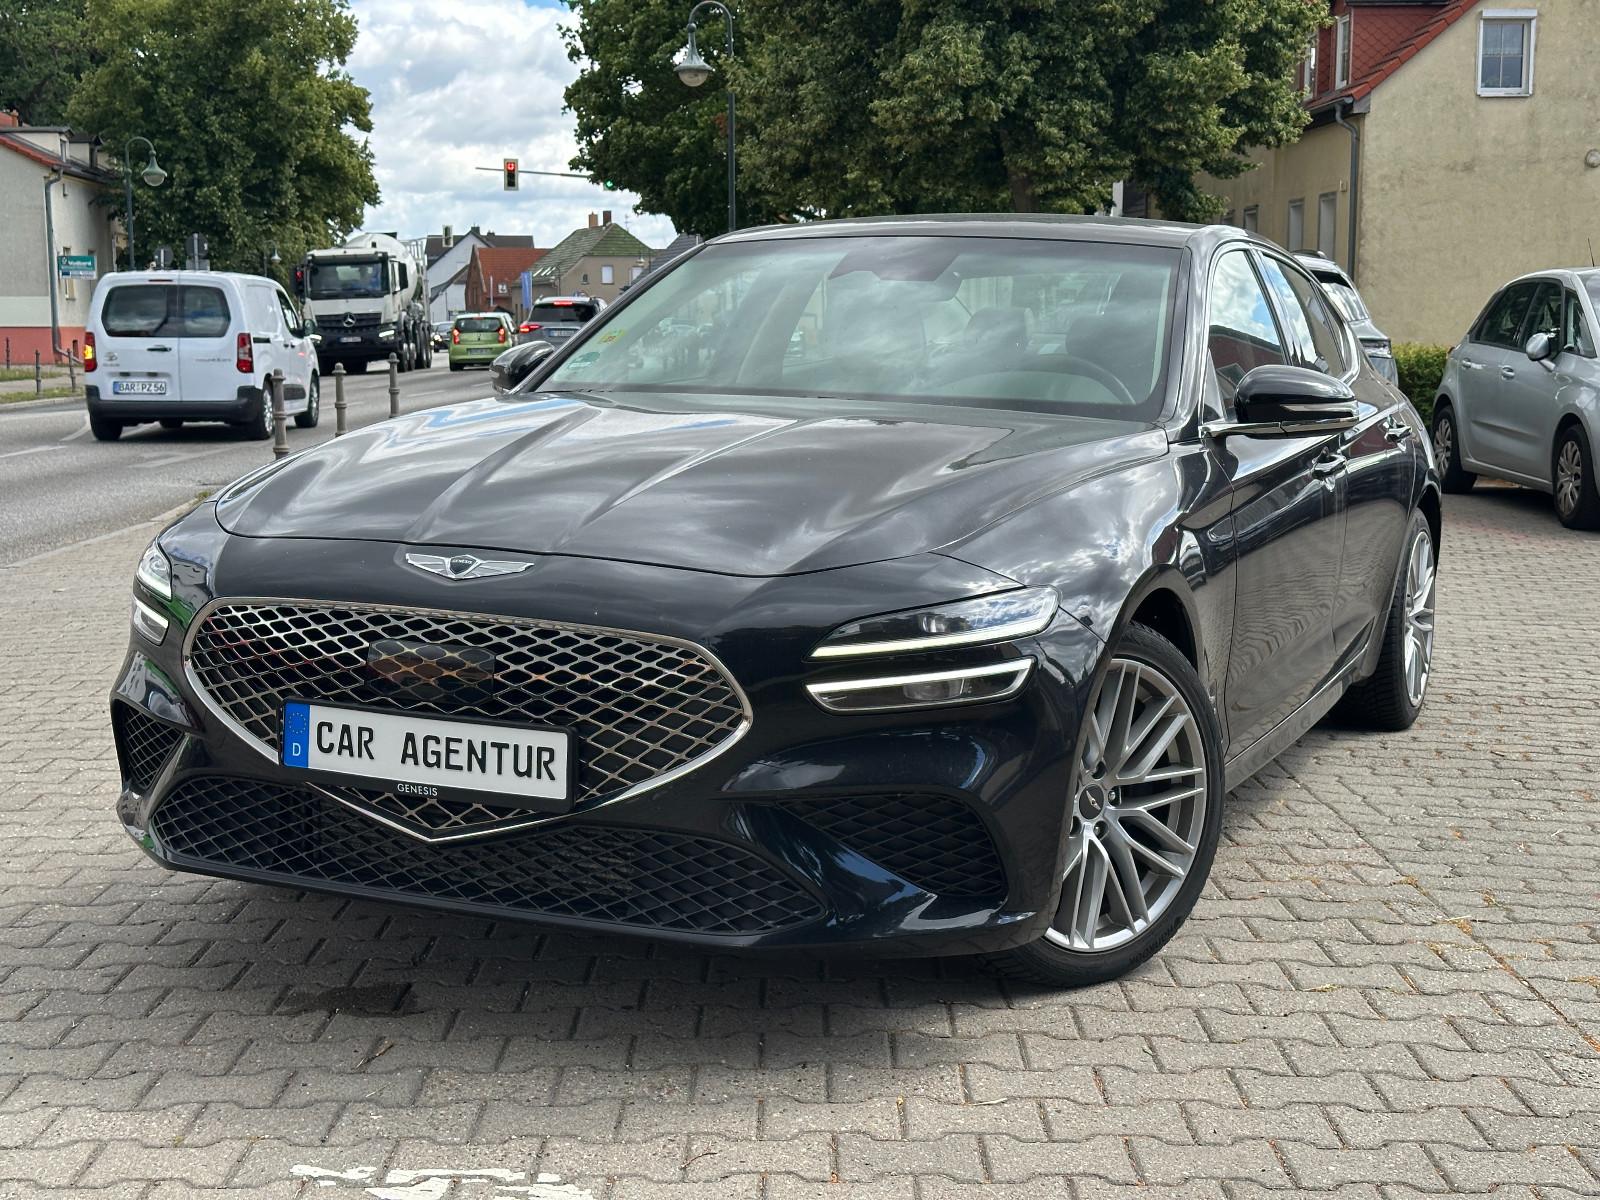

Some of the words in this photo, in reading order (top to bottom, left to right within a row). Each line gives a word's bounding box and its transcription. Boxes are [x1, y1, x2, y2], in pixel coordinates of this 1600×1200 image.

[119, 382, 136, 392] BAR
[141, 382, 152, 392] PZ
[153, 382, 165, 392] 56
[292, 742, 301, 757] D
[316, 721, 375, 760] CAR
[400, 732, 556, 781] AGENTUR
[397, 783, 438, 797] GENESIS
